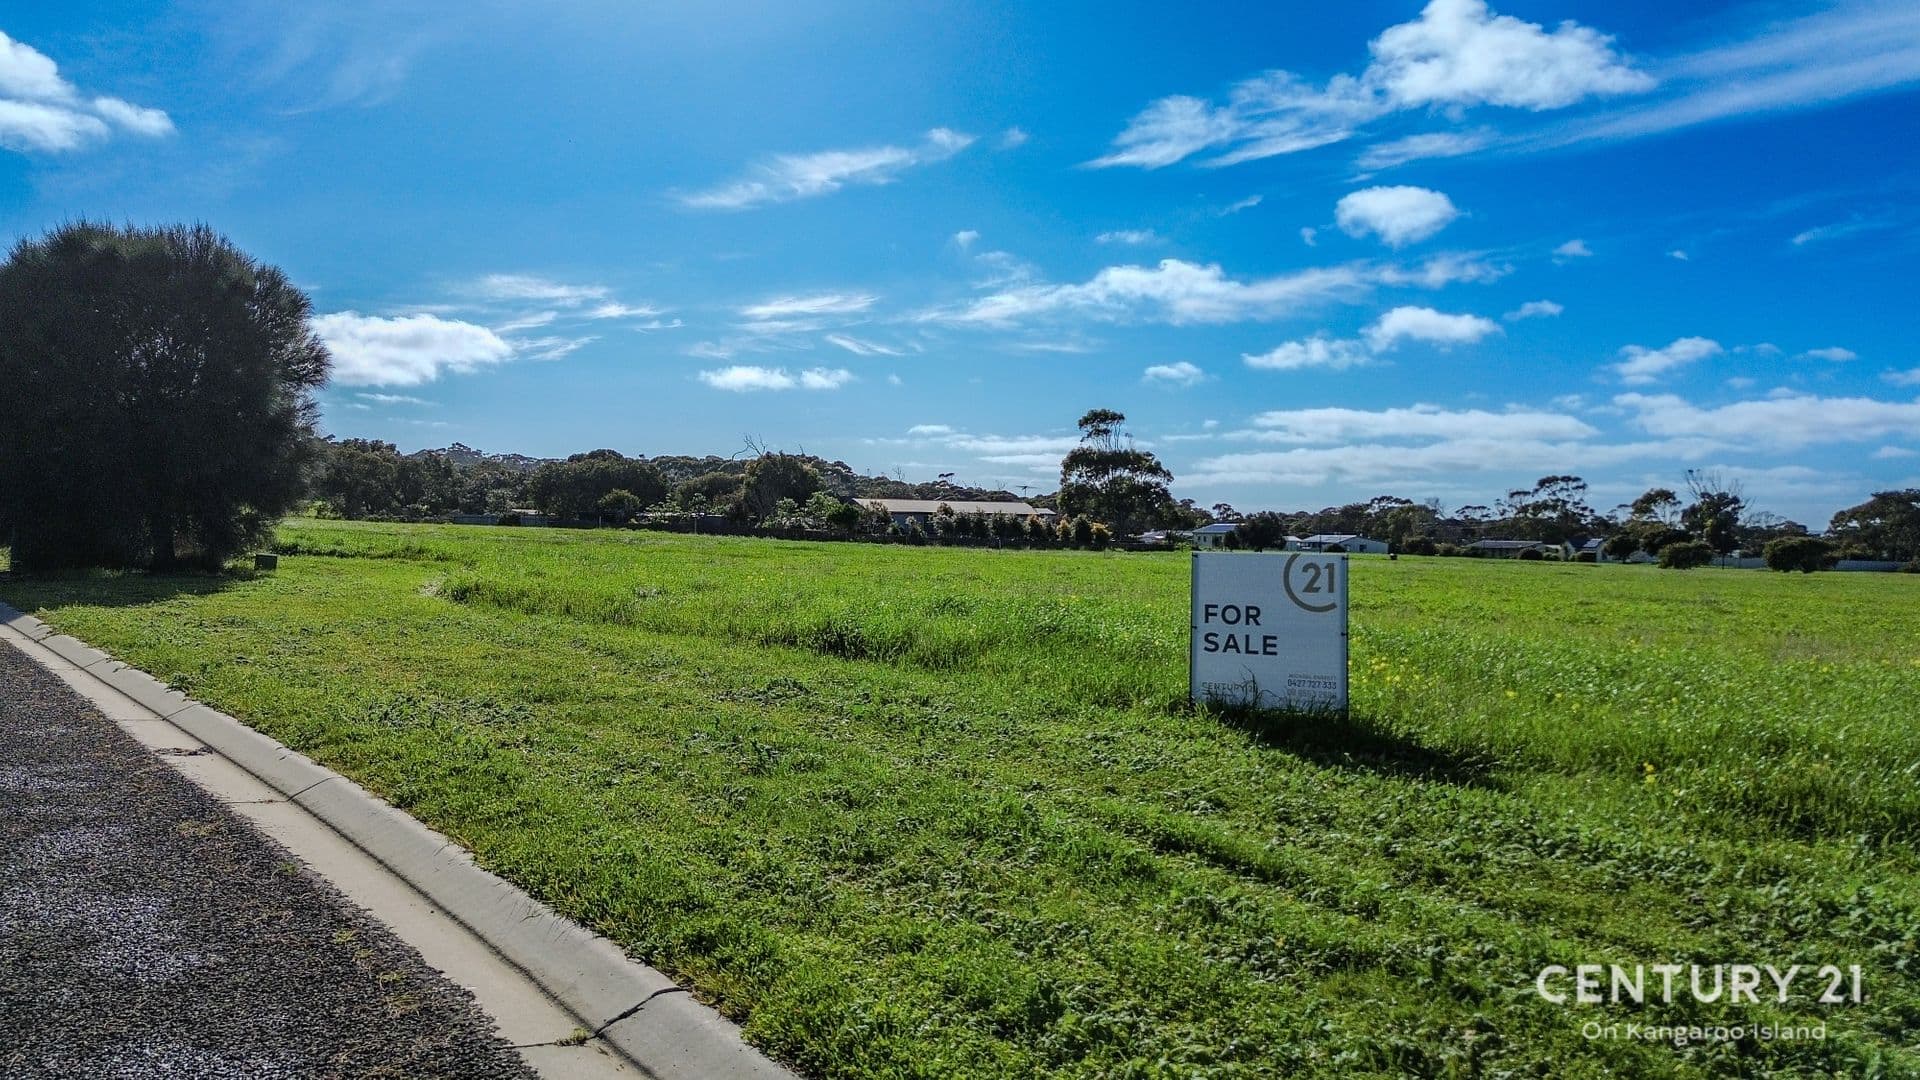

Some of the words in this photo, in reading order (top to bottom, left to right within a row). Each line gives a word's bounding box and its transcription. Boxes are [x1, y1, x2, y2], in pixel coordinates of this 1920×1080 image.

[1204, 604, 1261, 626] FOR
[1203, 632, 1278, 656] SALE
[1287, 679, 1306, 688] 0427
[1306, 680, 1321, 689] 727
